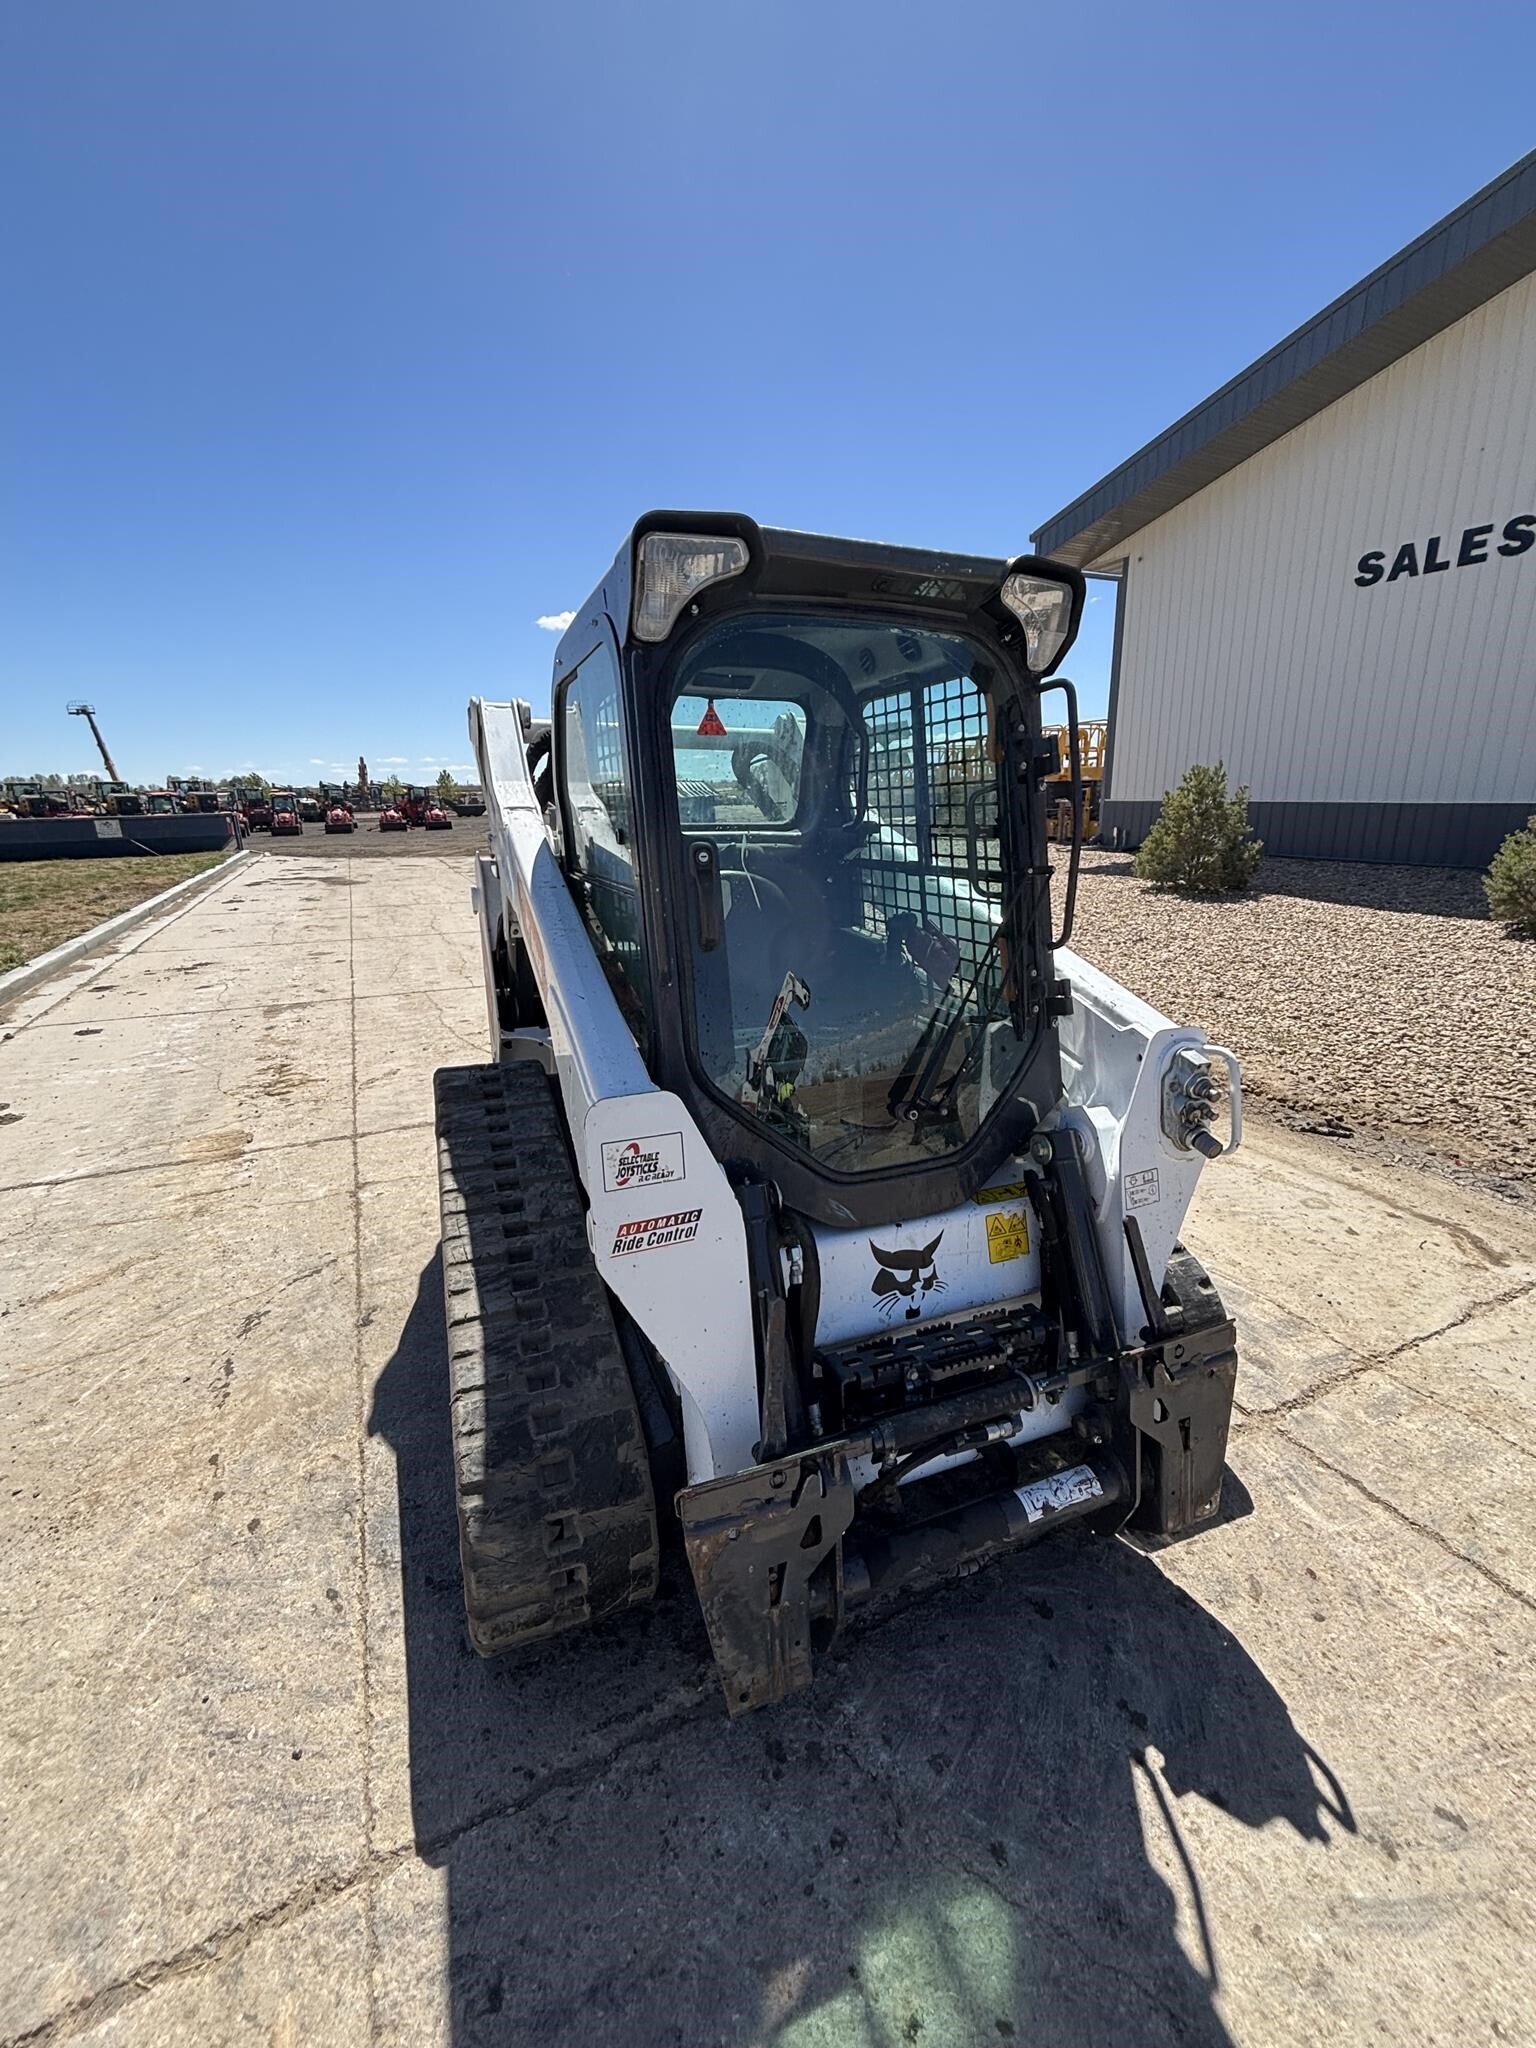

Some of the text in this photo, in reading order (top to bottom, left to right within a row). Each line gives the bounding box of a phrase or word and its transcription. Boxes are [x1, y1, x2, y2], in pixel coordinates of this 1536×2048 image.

[1354, 514, 1536, 587] SALES
[616, 1162, 659, 1179] JOYSTICKS
[618, 1152, 660, 1167] SELECTABLE
[619, 1211, 699, 1236] AUTOMATIC
[612, 1223, 699, 1255] Ride Control
